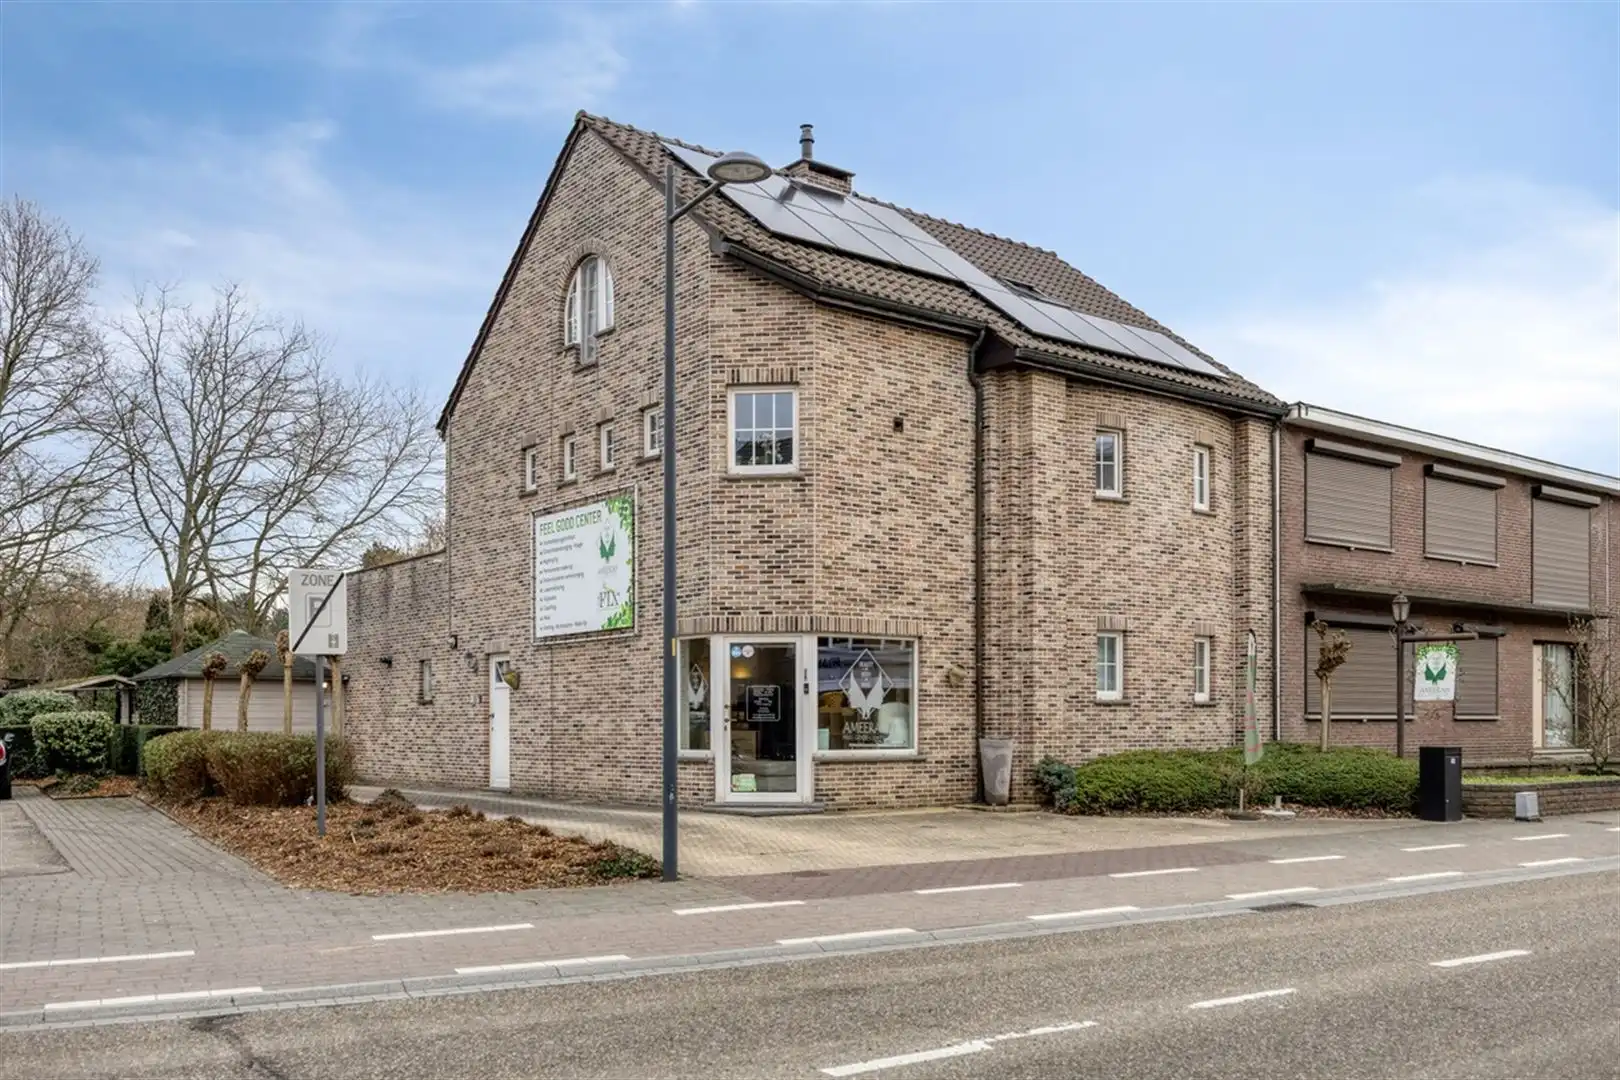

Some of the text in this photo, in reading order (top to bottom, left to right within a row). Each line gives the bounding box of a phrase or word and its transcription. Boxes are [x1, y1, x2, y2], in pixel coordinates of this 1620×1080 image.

[540, 509, 602, 536] FEEL GOOD CENTER
[301, 574, 334, 586] ZONE
